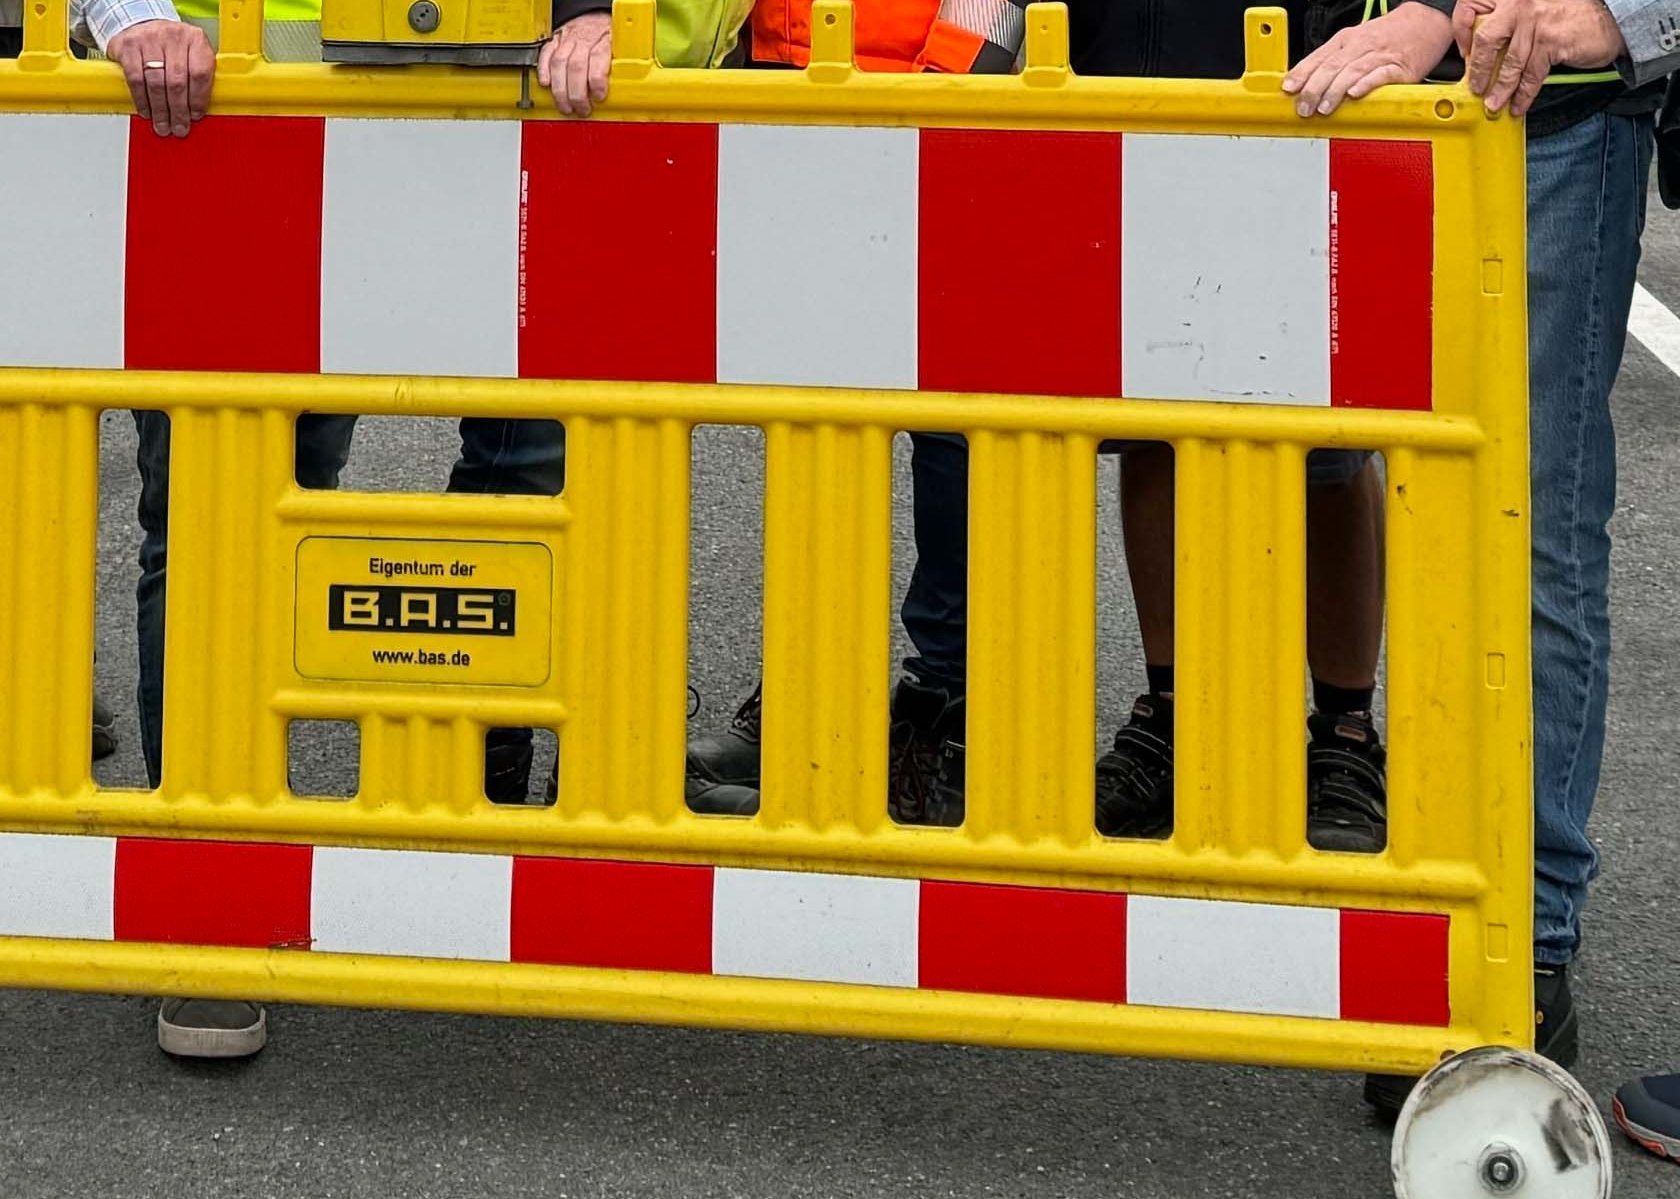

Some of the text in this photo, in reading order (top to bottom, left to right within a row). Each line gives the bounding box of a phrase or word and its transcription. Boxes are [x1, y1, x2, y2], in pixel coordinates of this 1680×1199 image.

[369, 557, 477, 578] Eigentum der
[343, 590, 509, 631] B.A.S.
[372, 648, 471, 667] www.bas.de
